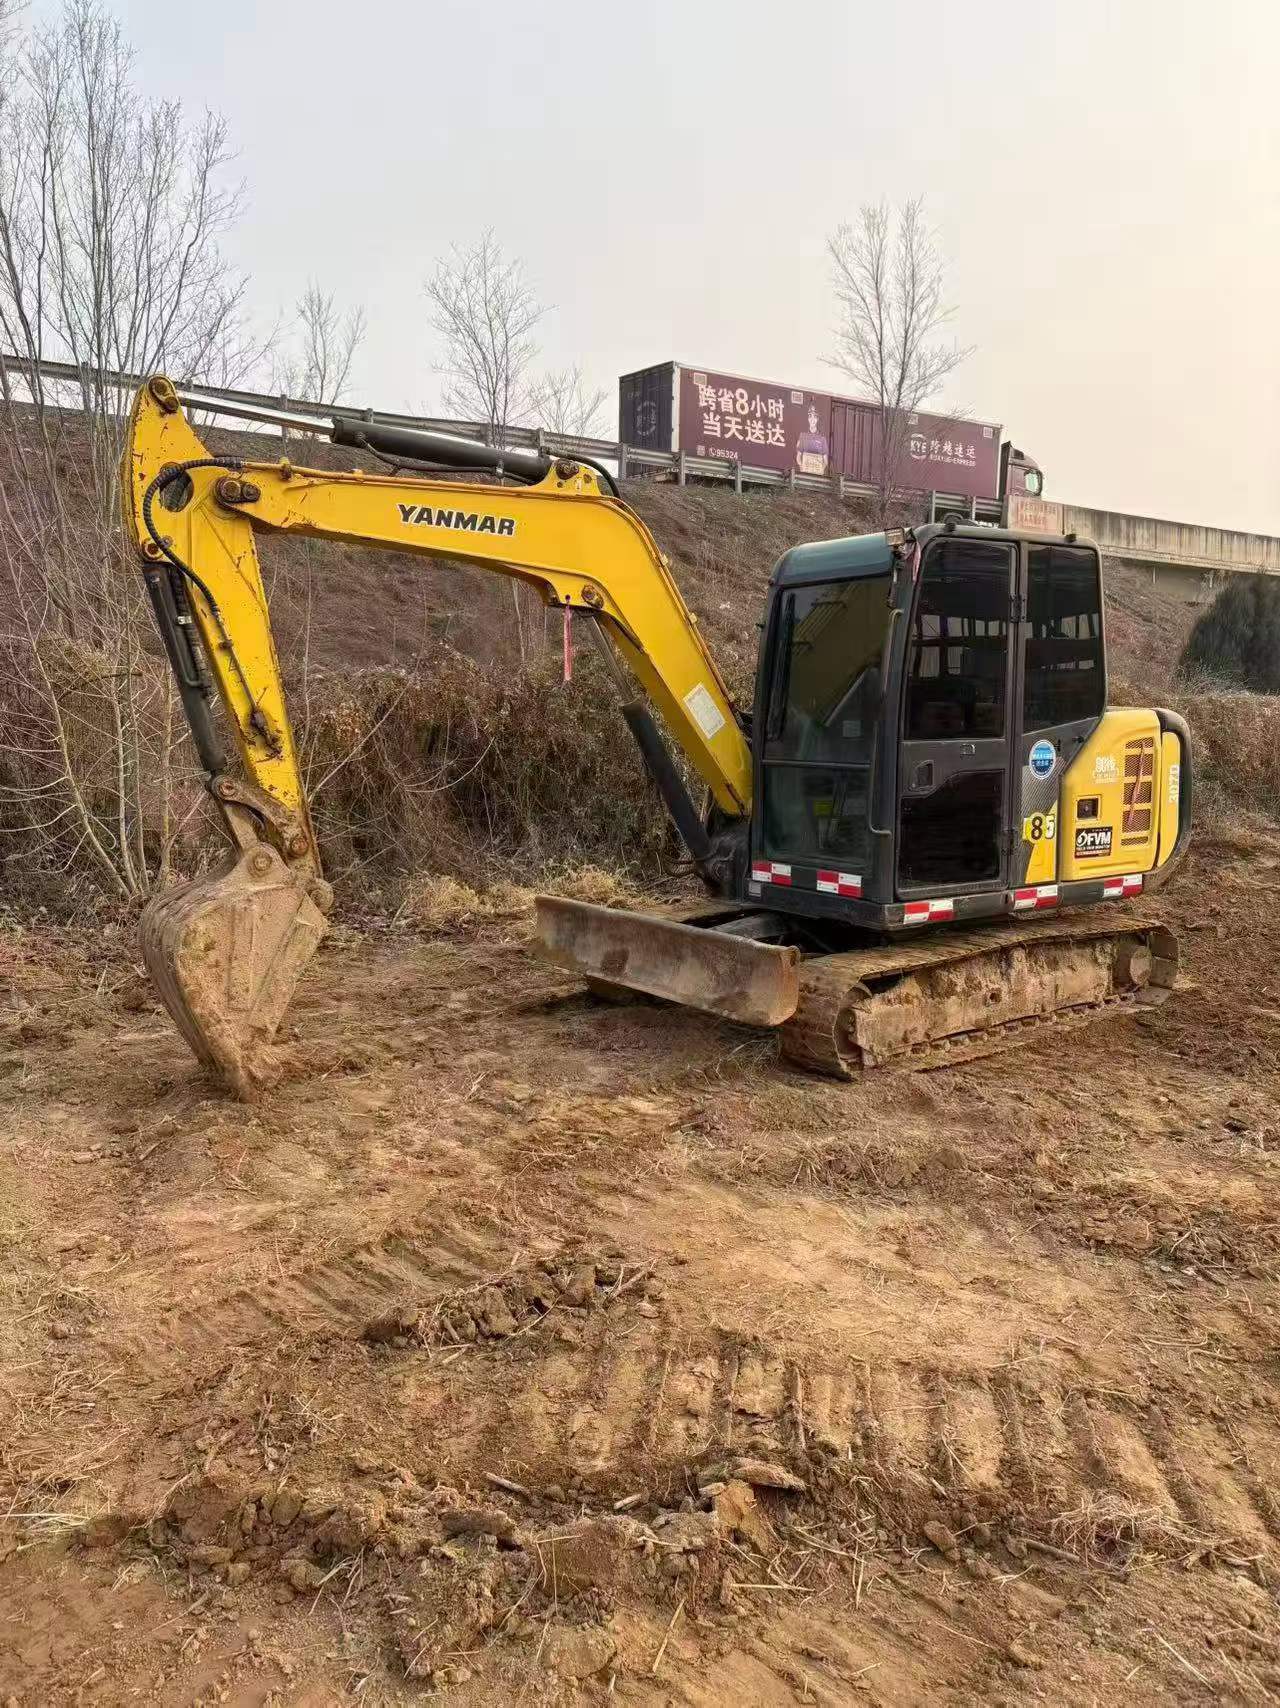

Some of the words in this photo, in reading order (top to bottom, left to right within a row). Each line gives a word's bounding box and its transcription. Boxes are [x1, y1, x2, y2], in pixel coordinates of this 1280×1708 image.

[698, 384, 785, 422] 跨省8小时
[702, 411, 786, 447] 当天送达
[716, 448, 738, 460] 95324
[910, 439, 927, 453] KYE
[397, 503, 516, 536] YANMAR
[1030, 815, 1055, 840] 85
